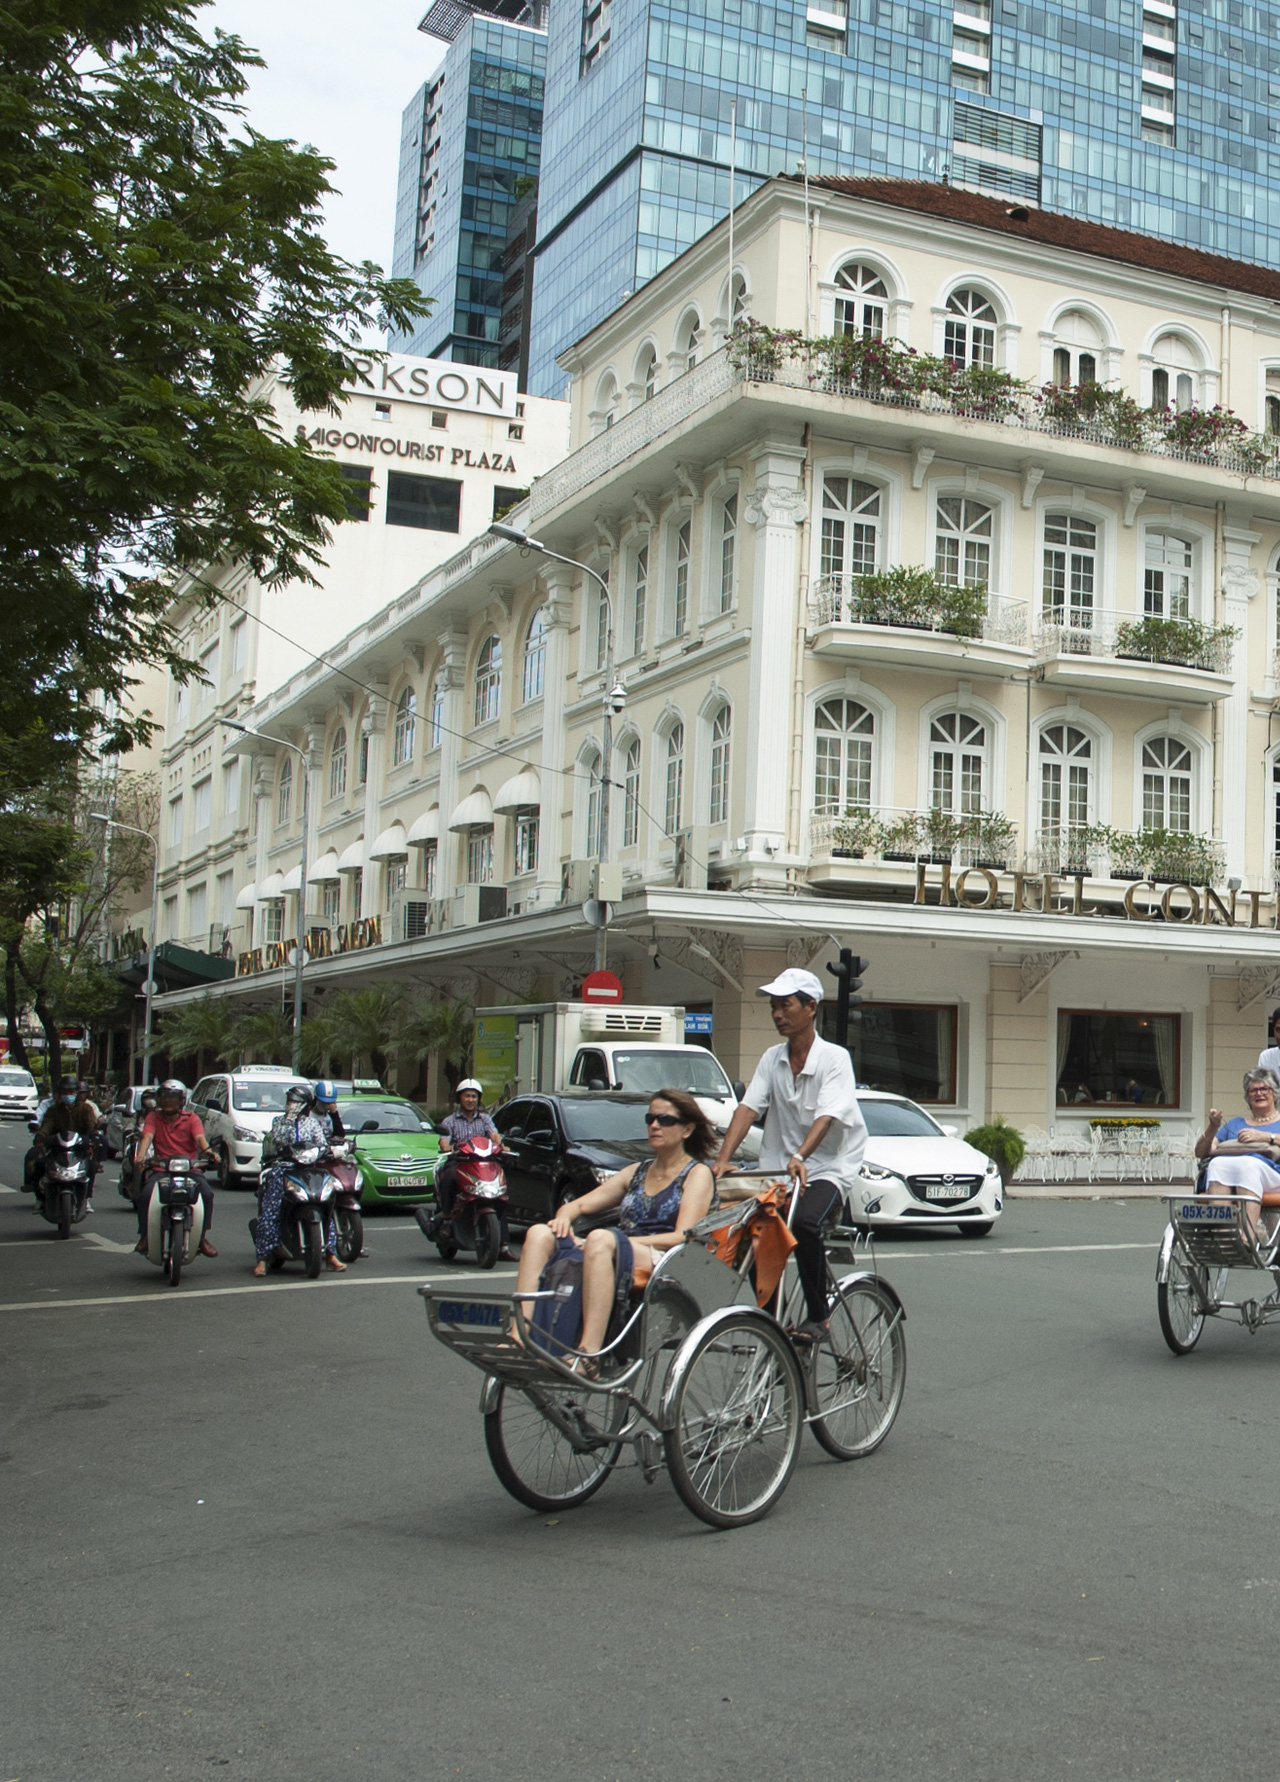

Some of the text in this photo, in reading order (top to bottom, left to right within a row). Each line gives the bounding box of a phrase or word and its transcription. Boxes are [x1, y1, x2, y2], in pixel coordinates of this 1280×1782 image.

[353, 356, 505, 409] RKSON
[296, 424, 516, 473] SAIGONTOURIST PLAZA
[913, 863, 1097, 916] HOTEL
[1182, 1204, 1232, 1219] Q5X-375A
